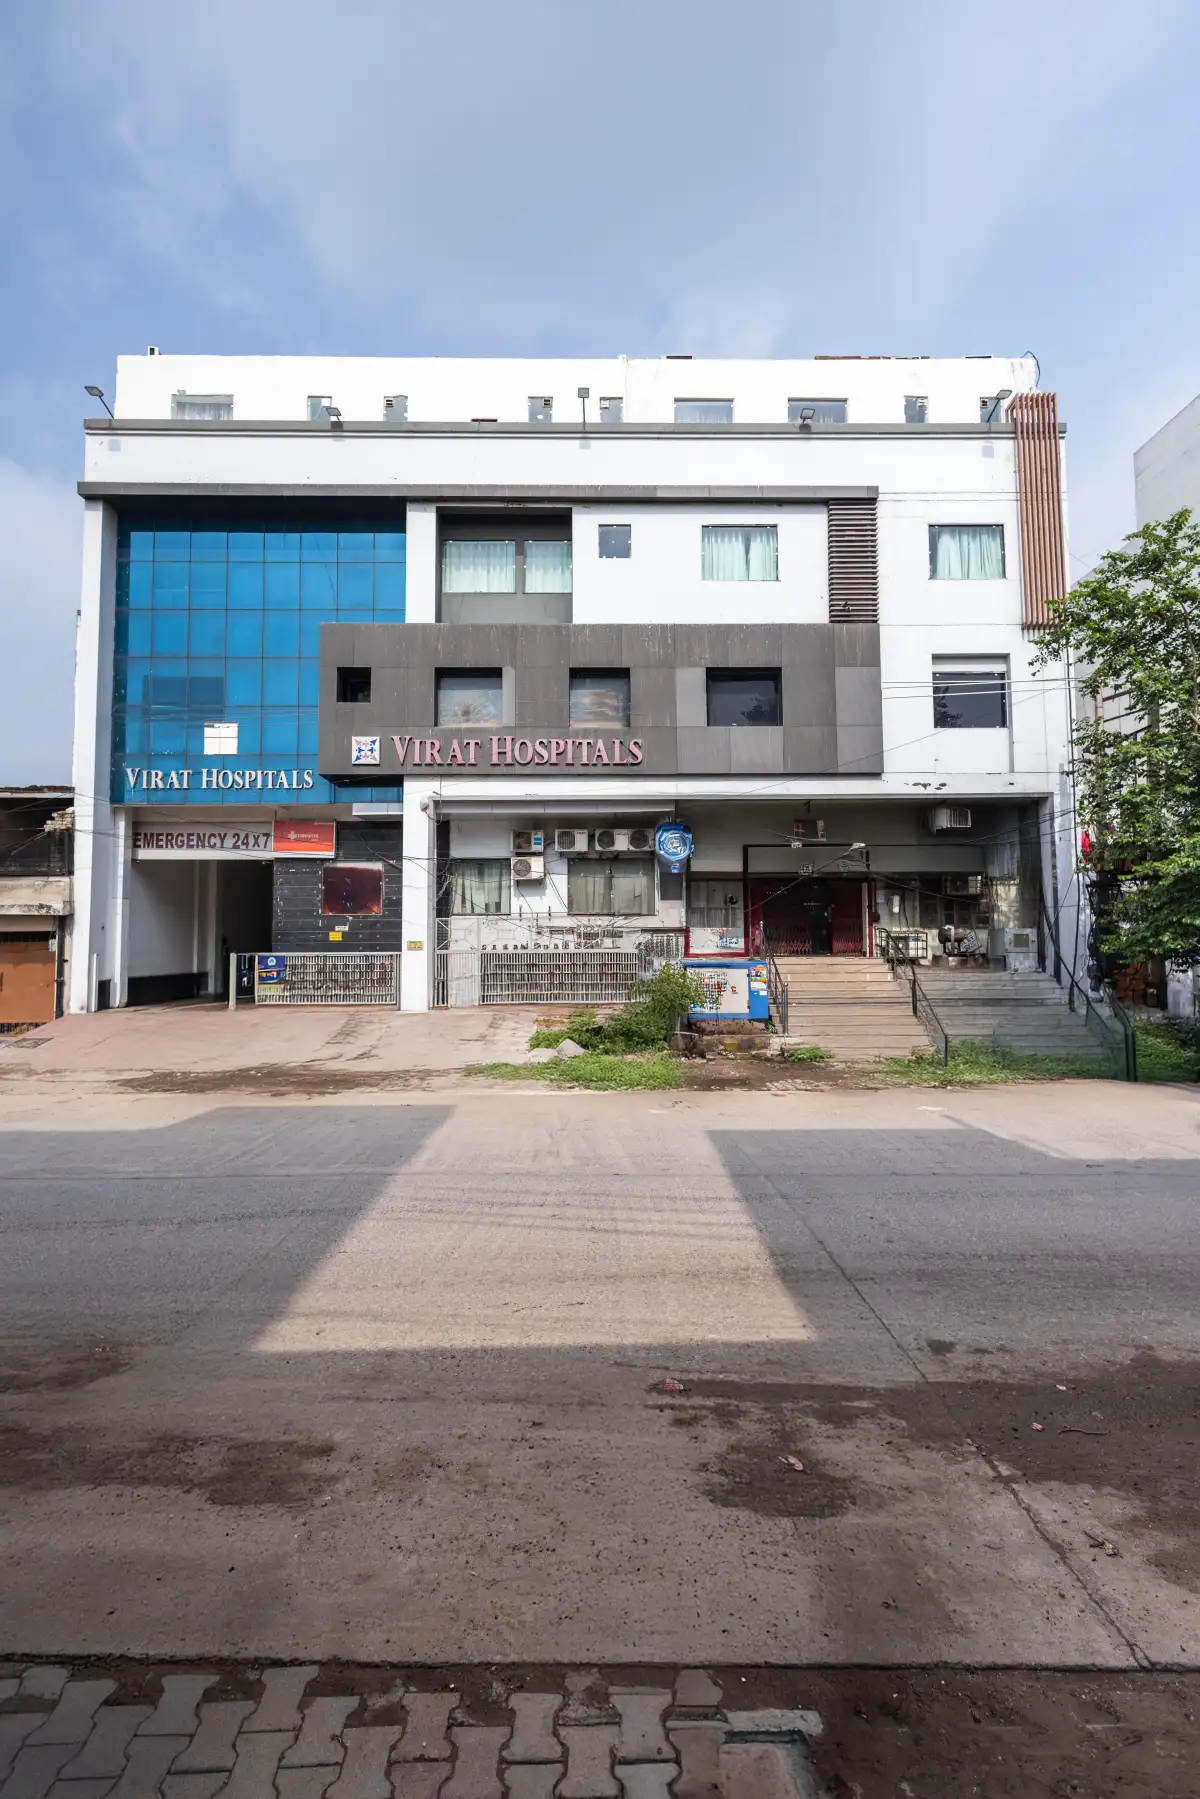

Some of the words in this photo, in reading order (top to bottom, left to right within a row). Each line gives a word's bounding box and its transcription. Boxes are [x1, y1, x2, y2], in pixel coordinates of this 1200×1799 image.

[391, 735, 481, 765] VIRAT
[489, 735, 643, 765] HOSPITALS
[126, 767, 192, 789] VIRAT
[201, 768, 314, 789] HOSPITALS
[134, 832, 228, 849] EMERGENCY
